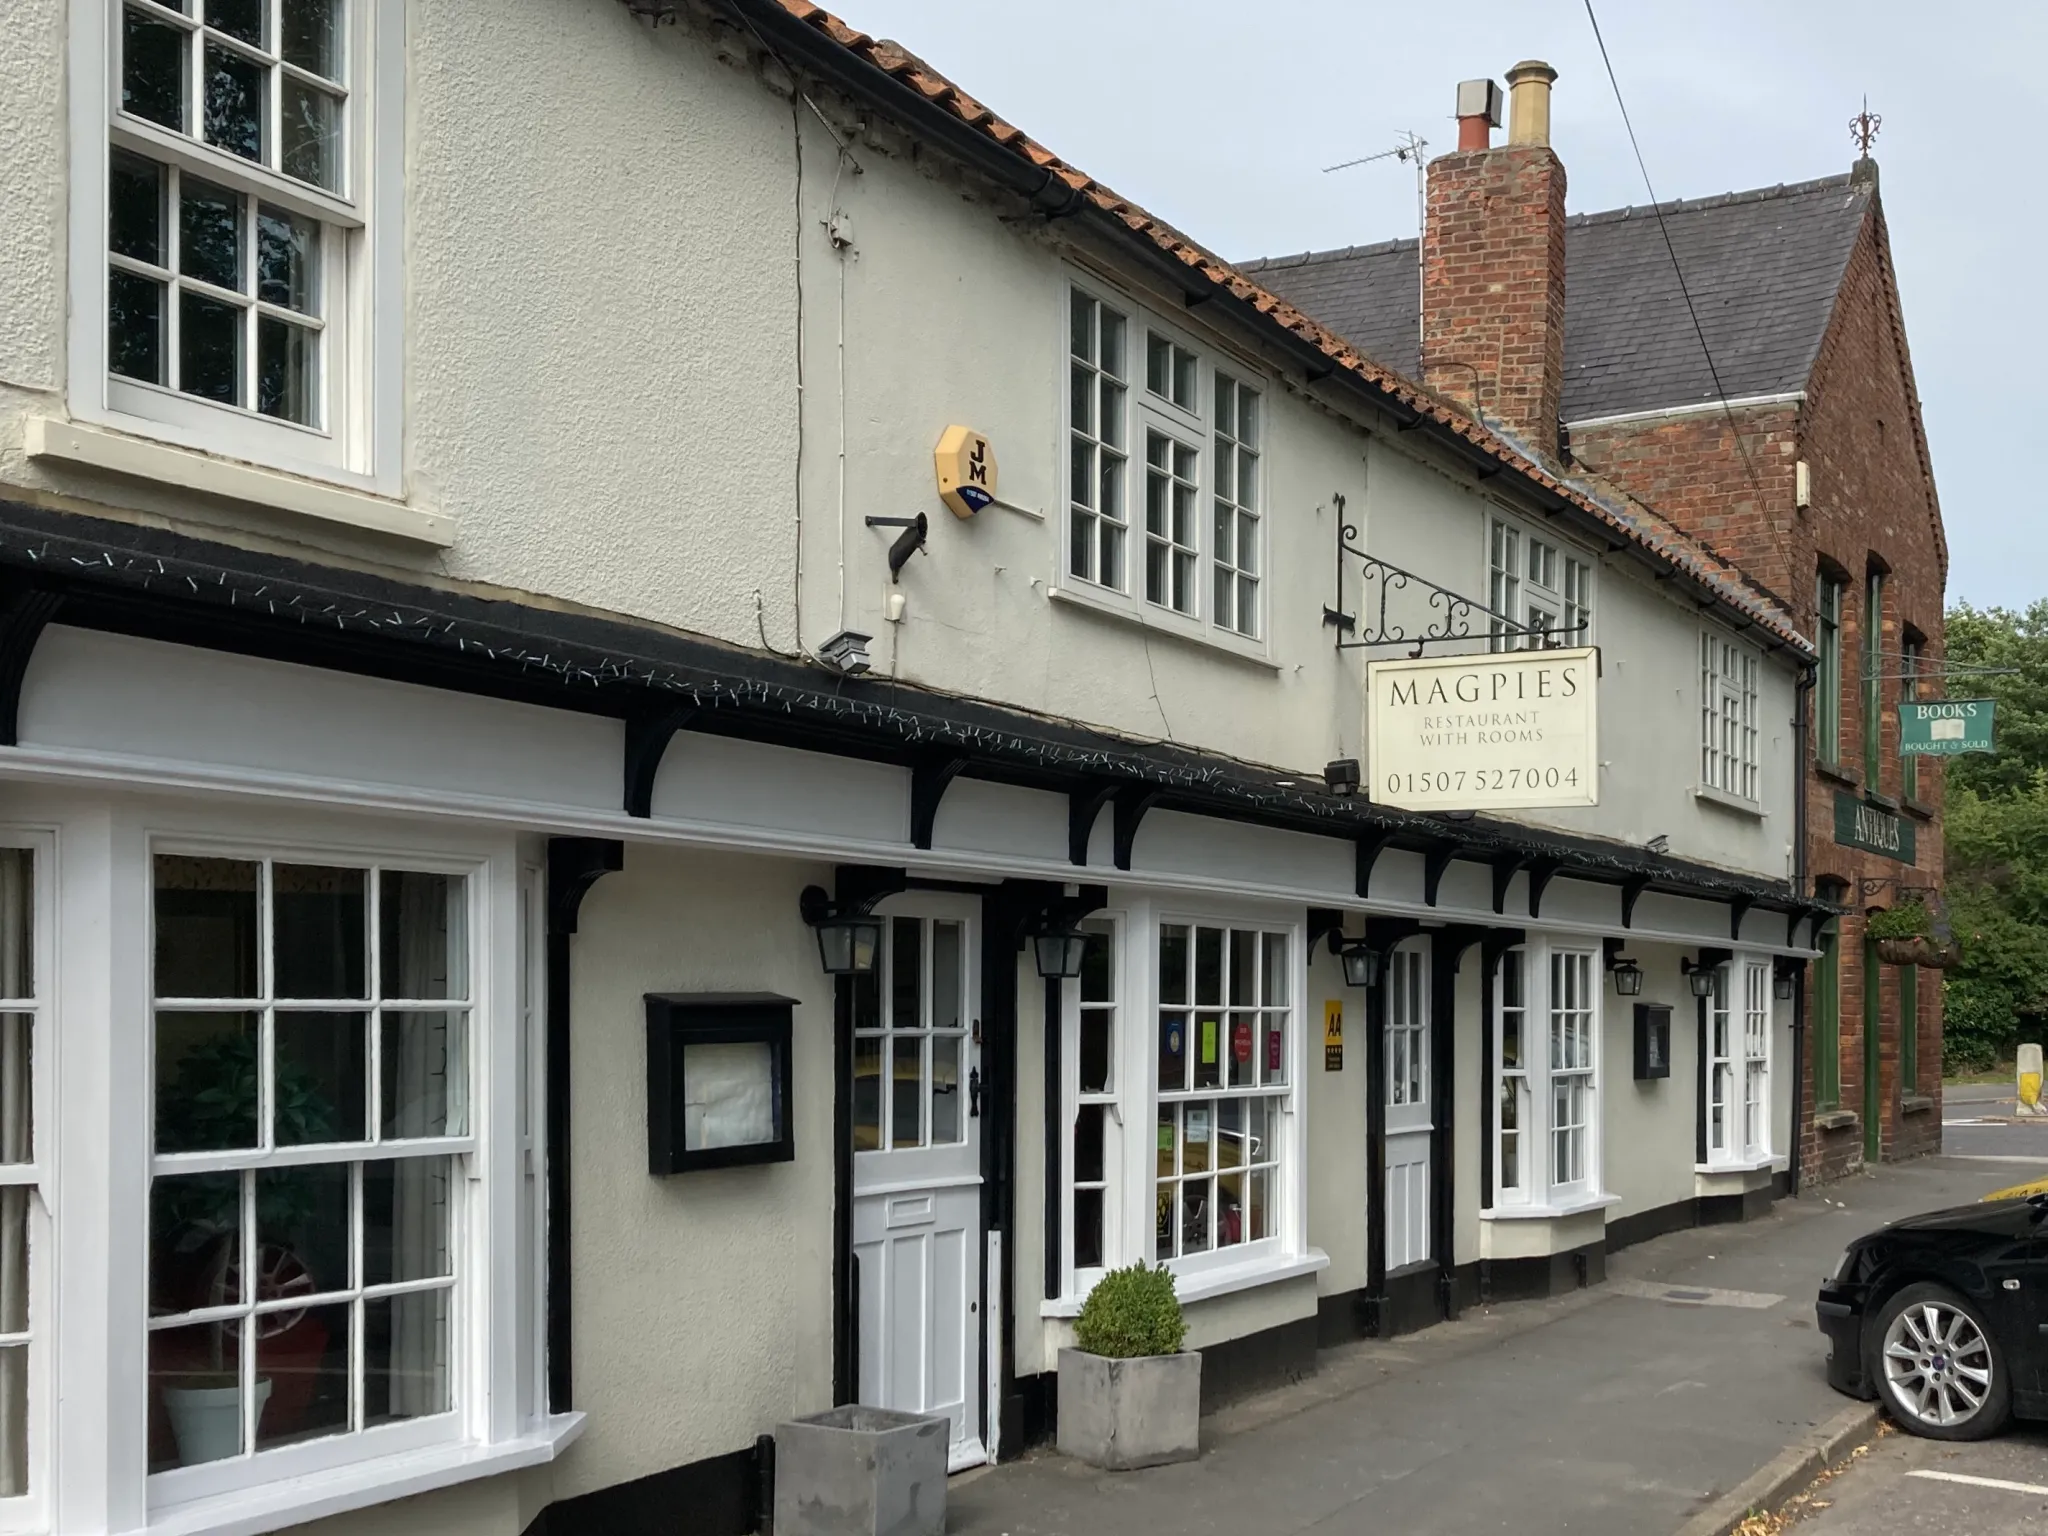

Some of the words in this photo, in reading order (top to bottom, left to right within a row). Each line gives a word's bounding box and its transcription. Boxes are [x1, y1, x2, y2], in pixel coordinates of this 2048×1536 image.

[1390, 668, 1577, 706] MAGPIES
[1424, 711, 1540, 729] RESTAURANT
[1917, 703, 1977, 719] BOOKS
[1420, 732, 1468, 746] WITH
[1478, 729, 1543, 744] ROOMS
[1905, 741, 1948, 750] BOUGHT
[1950, 741, 1958, 749] &
[1962, 740, 1988, 748] SOLD
[1388, 771, 1466, 793] 01507
[1475, 767, 1579, 790] 527004
[1854, 806, 1900, 852] ANTIQUES
[1328, 1013, 1341, 1037] AA
